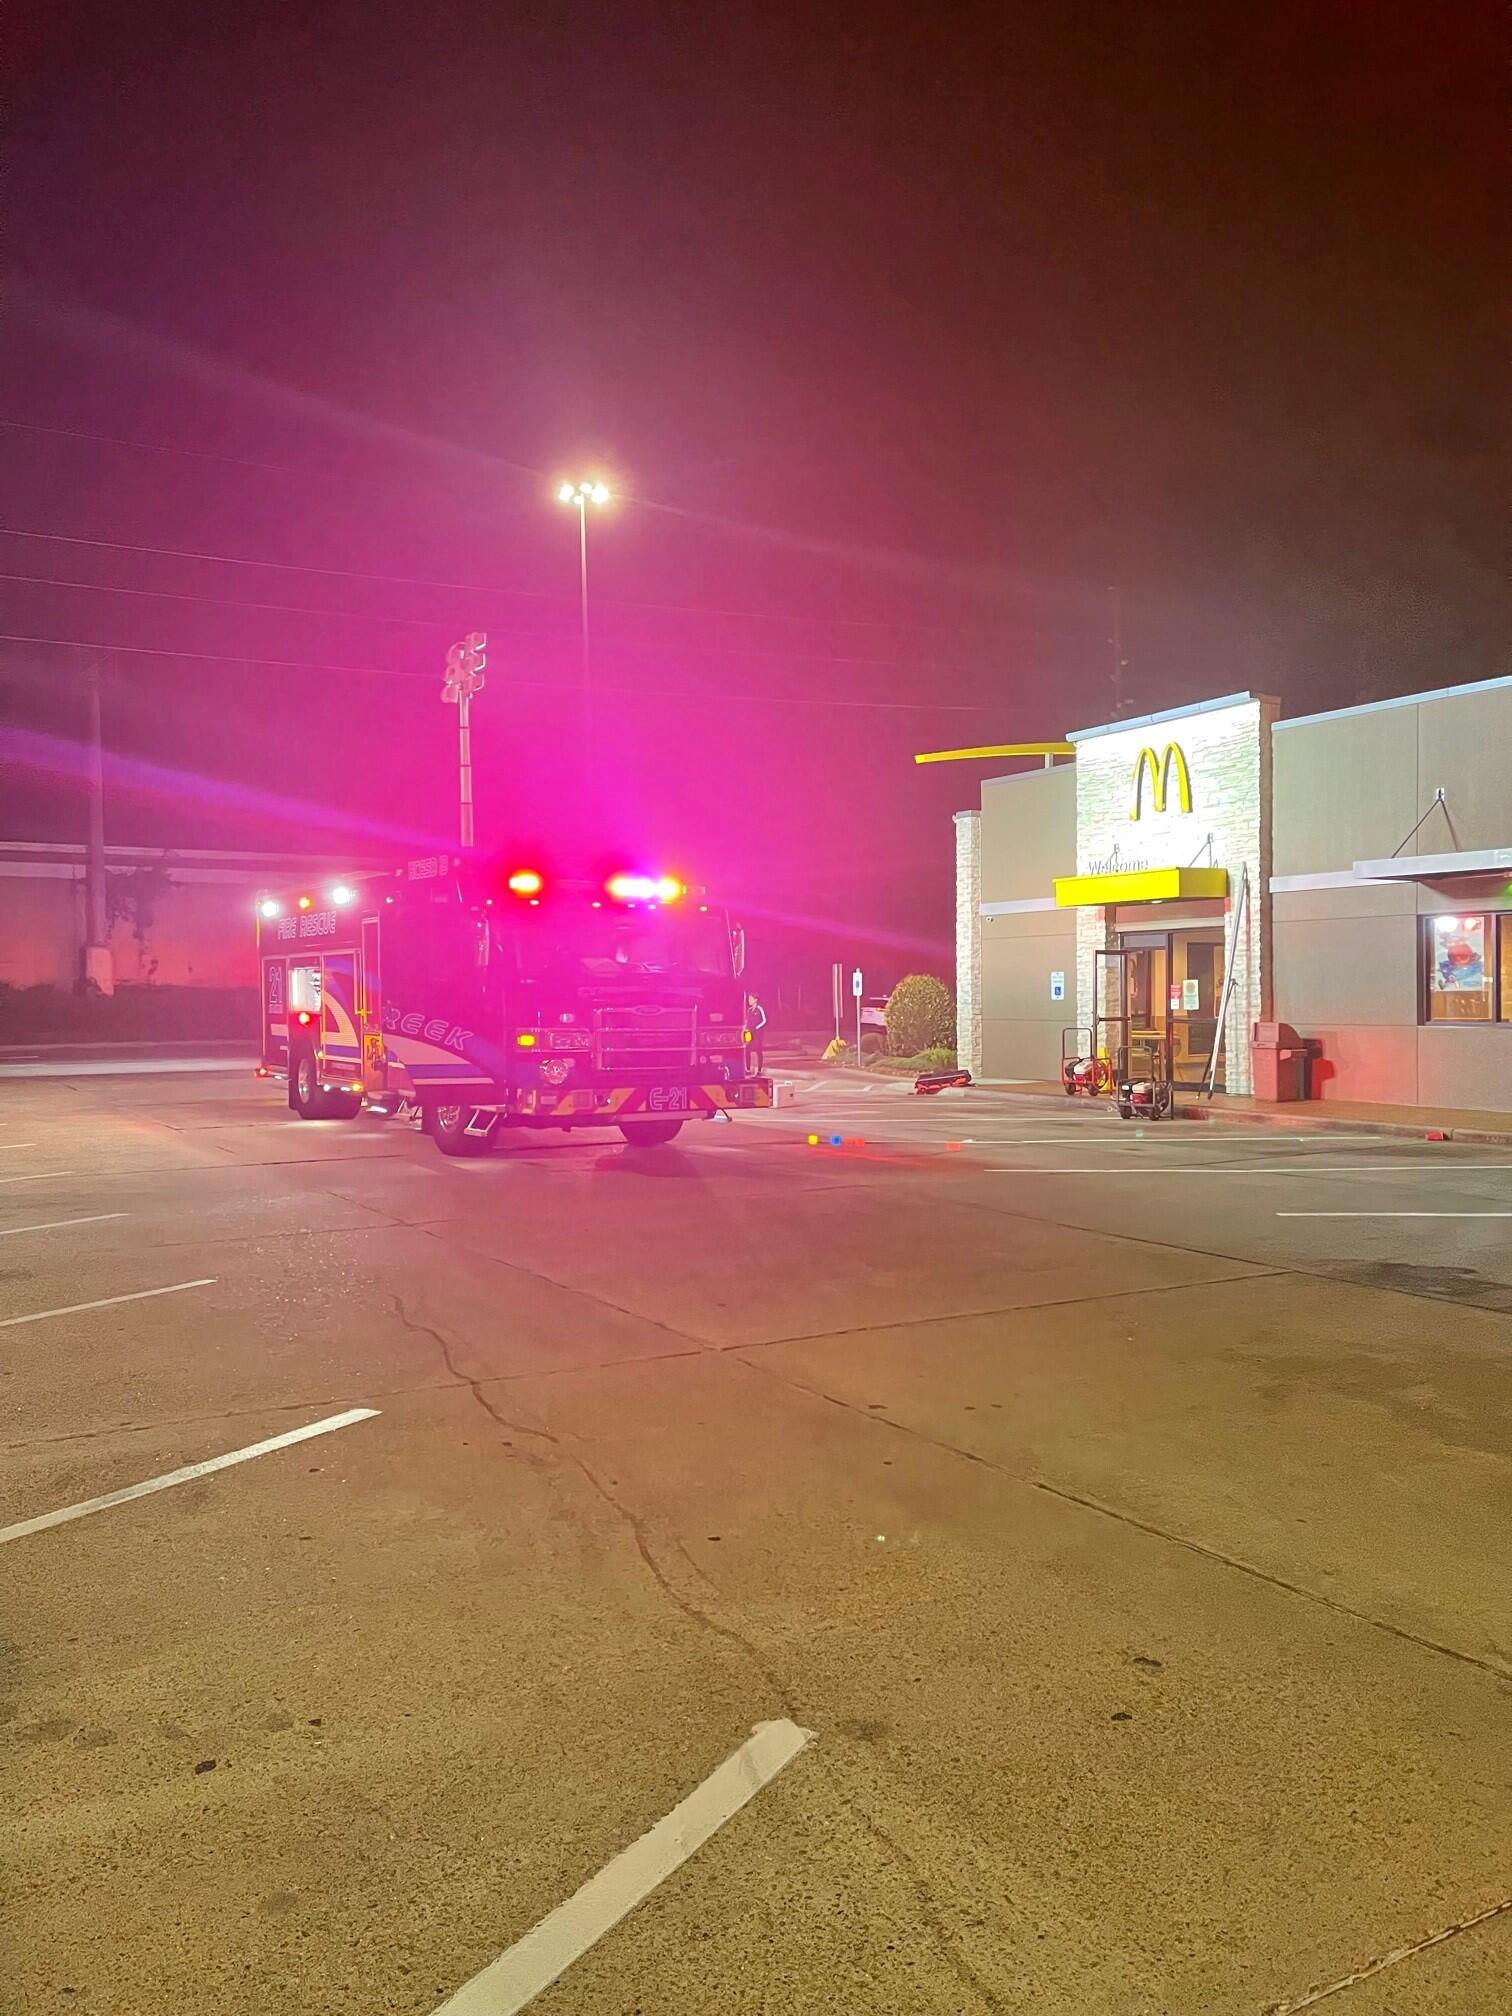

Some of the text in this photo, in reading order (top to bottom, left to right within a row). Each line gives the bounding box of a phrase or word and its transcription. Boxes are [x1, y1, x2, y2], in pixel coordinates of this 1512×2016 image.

[1088, 859, 1149, 875] Welcome
[278, 911, 337, 940] FIRE RESCUE
[269, 966, 283, 1003] 21
